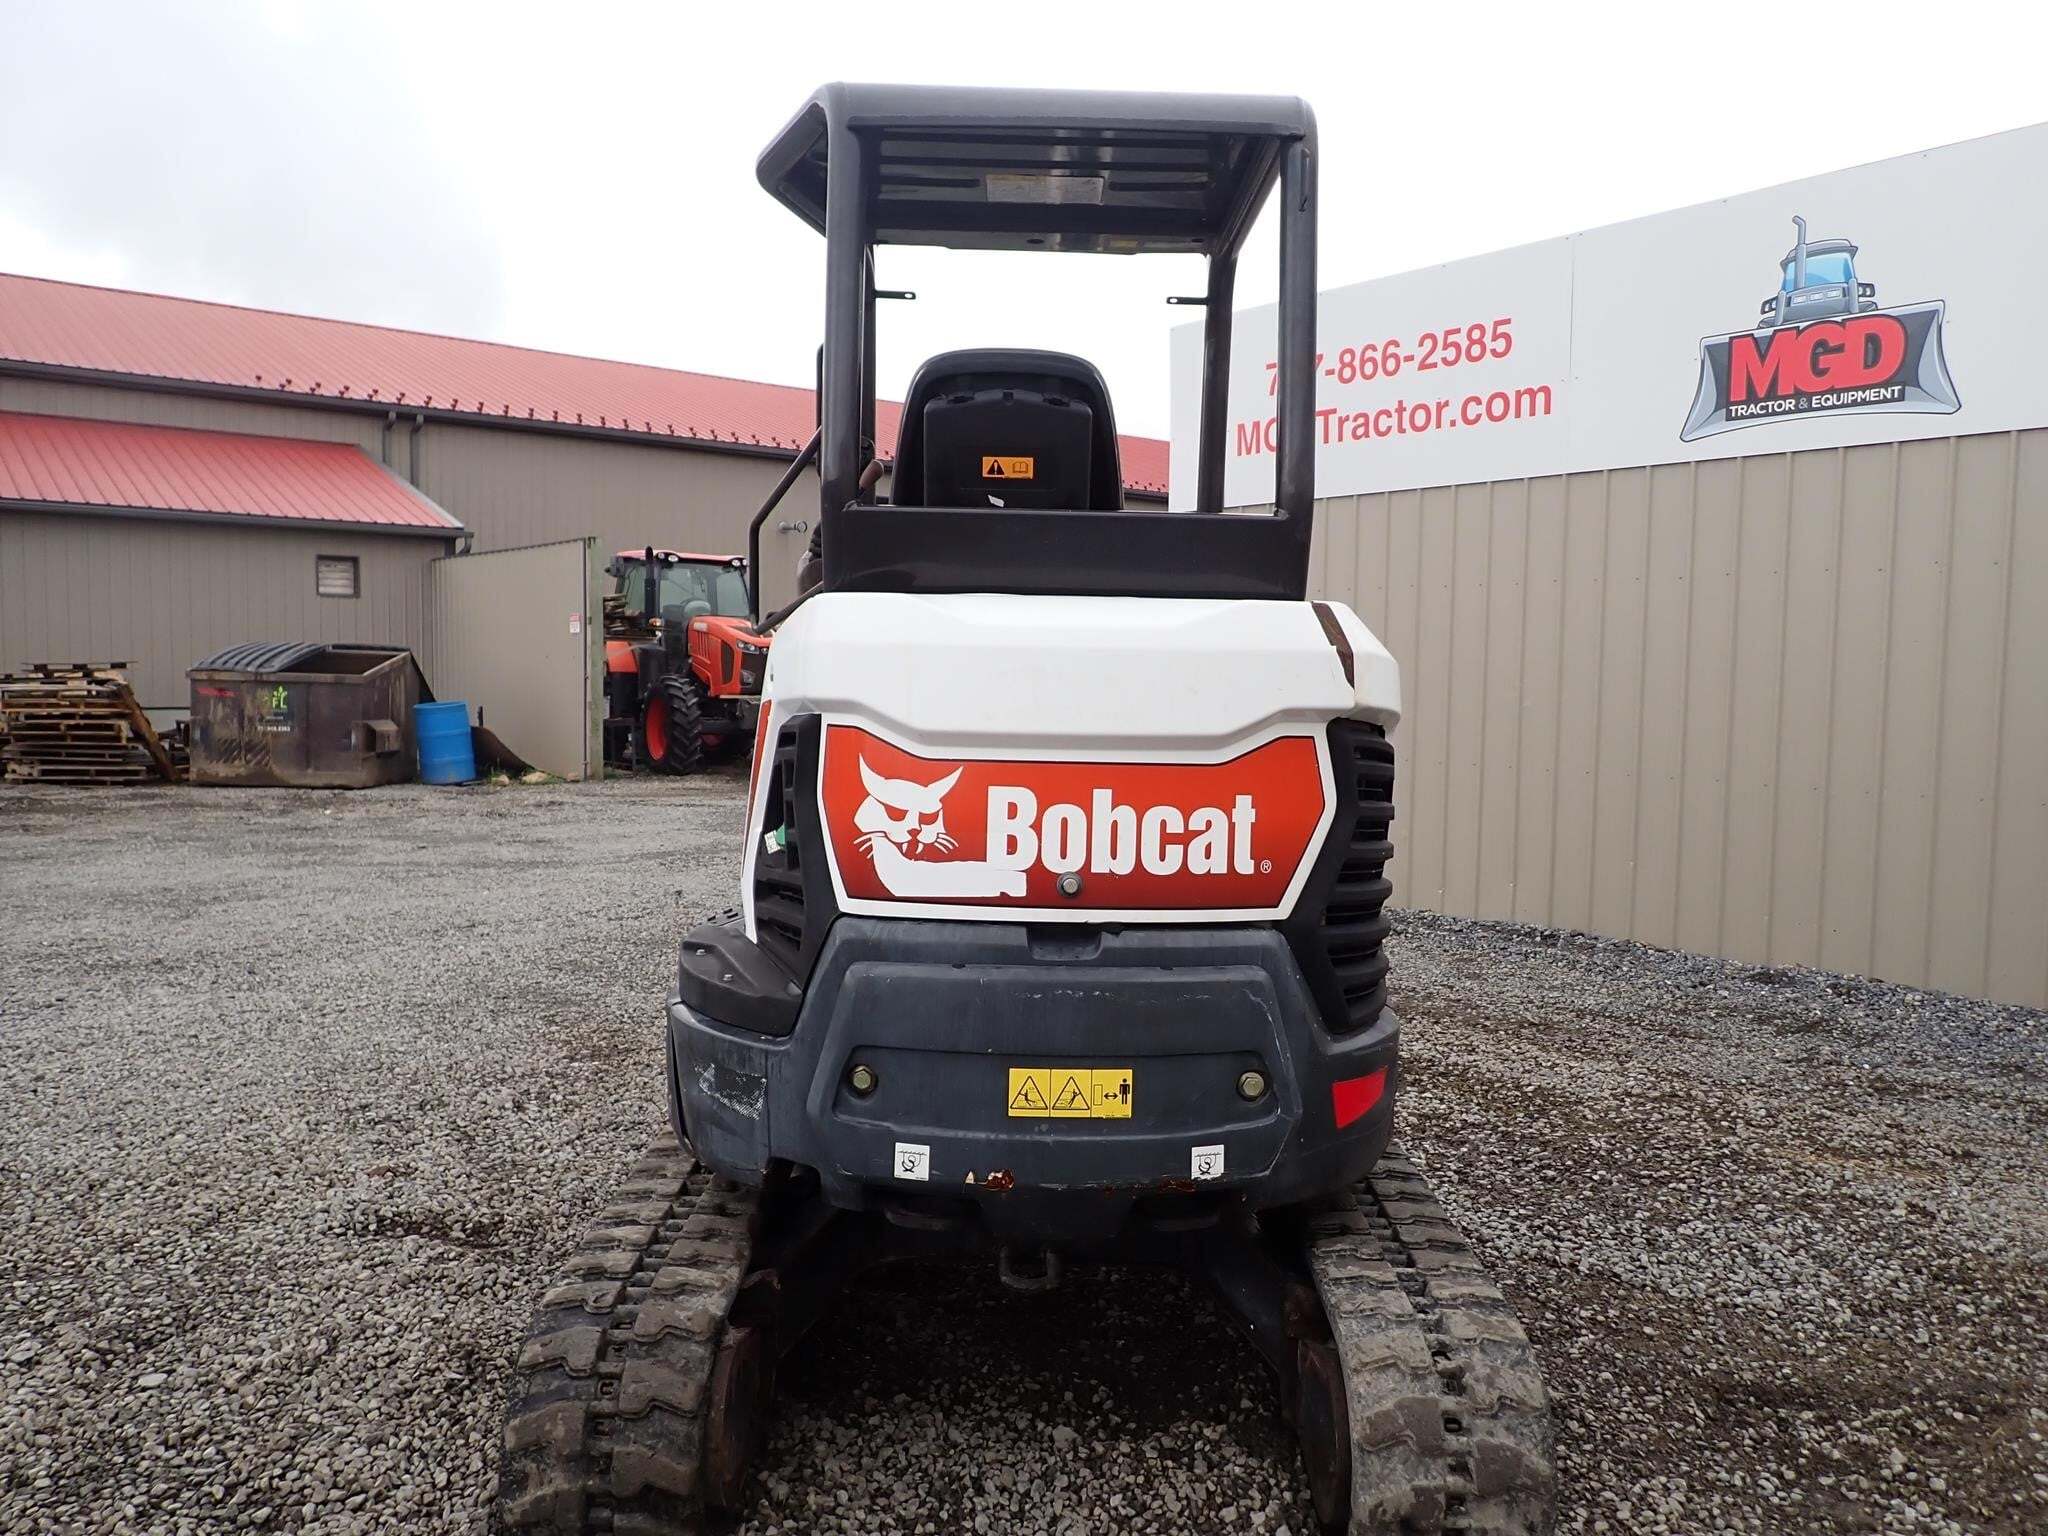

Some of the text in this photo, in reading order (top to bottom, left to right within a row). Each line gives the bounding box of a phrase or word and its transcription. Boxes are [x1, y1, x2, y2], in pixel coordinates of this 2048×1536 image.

[1266, 318, 1512, 396] 7-866-2585
[1730, 315, 1906, 402] MGD
[1237, 385, 1552, 456] MTractor.com
[1730, 386, 1902, 416] TRACTOR & EQUIPMENT
[987, 786, 1256, 875] Bobcat
